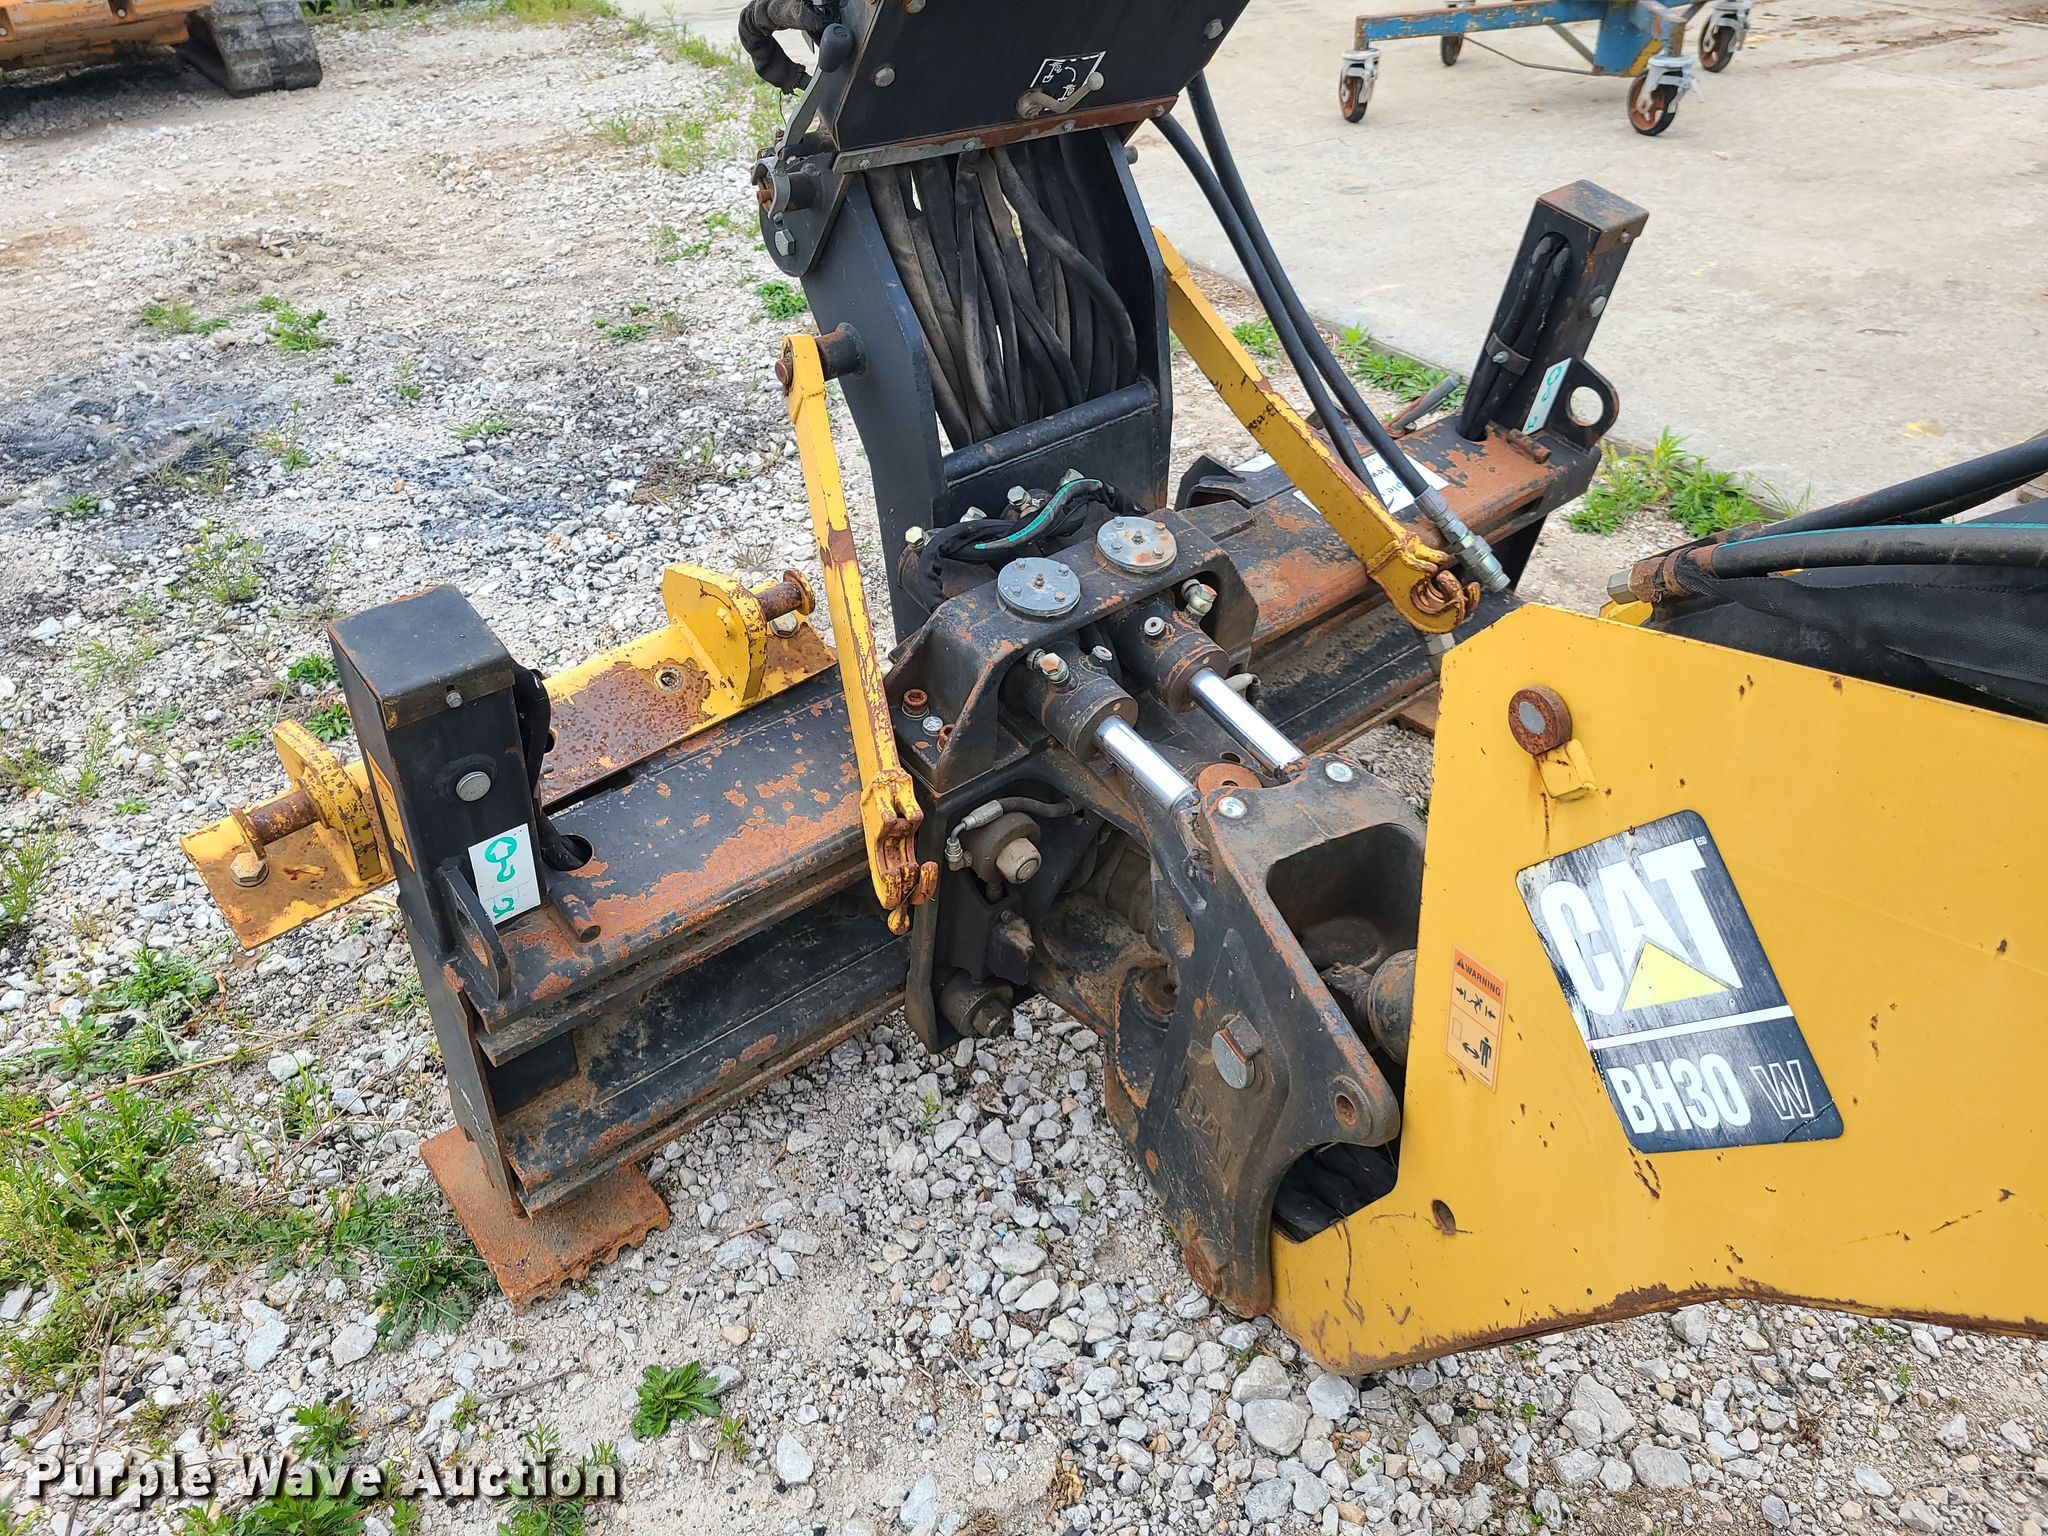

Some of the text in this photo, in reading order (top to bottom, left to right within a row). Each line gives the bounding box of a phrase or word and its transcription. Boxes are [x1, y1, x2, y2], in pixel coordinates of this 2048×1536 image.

[1540, 838, 1743, 1016] CAT
[1464, 964, 1501, 997] WARNING
[1606, 1053, 1814, 1134] BH30 W
